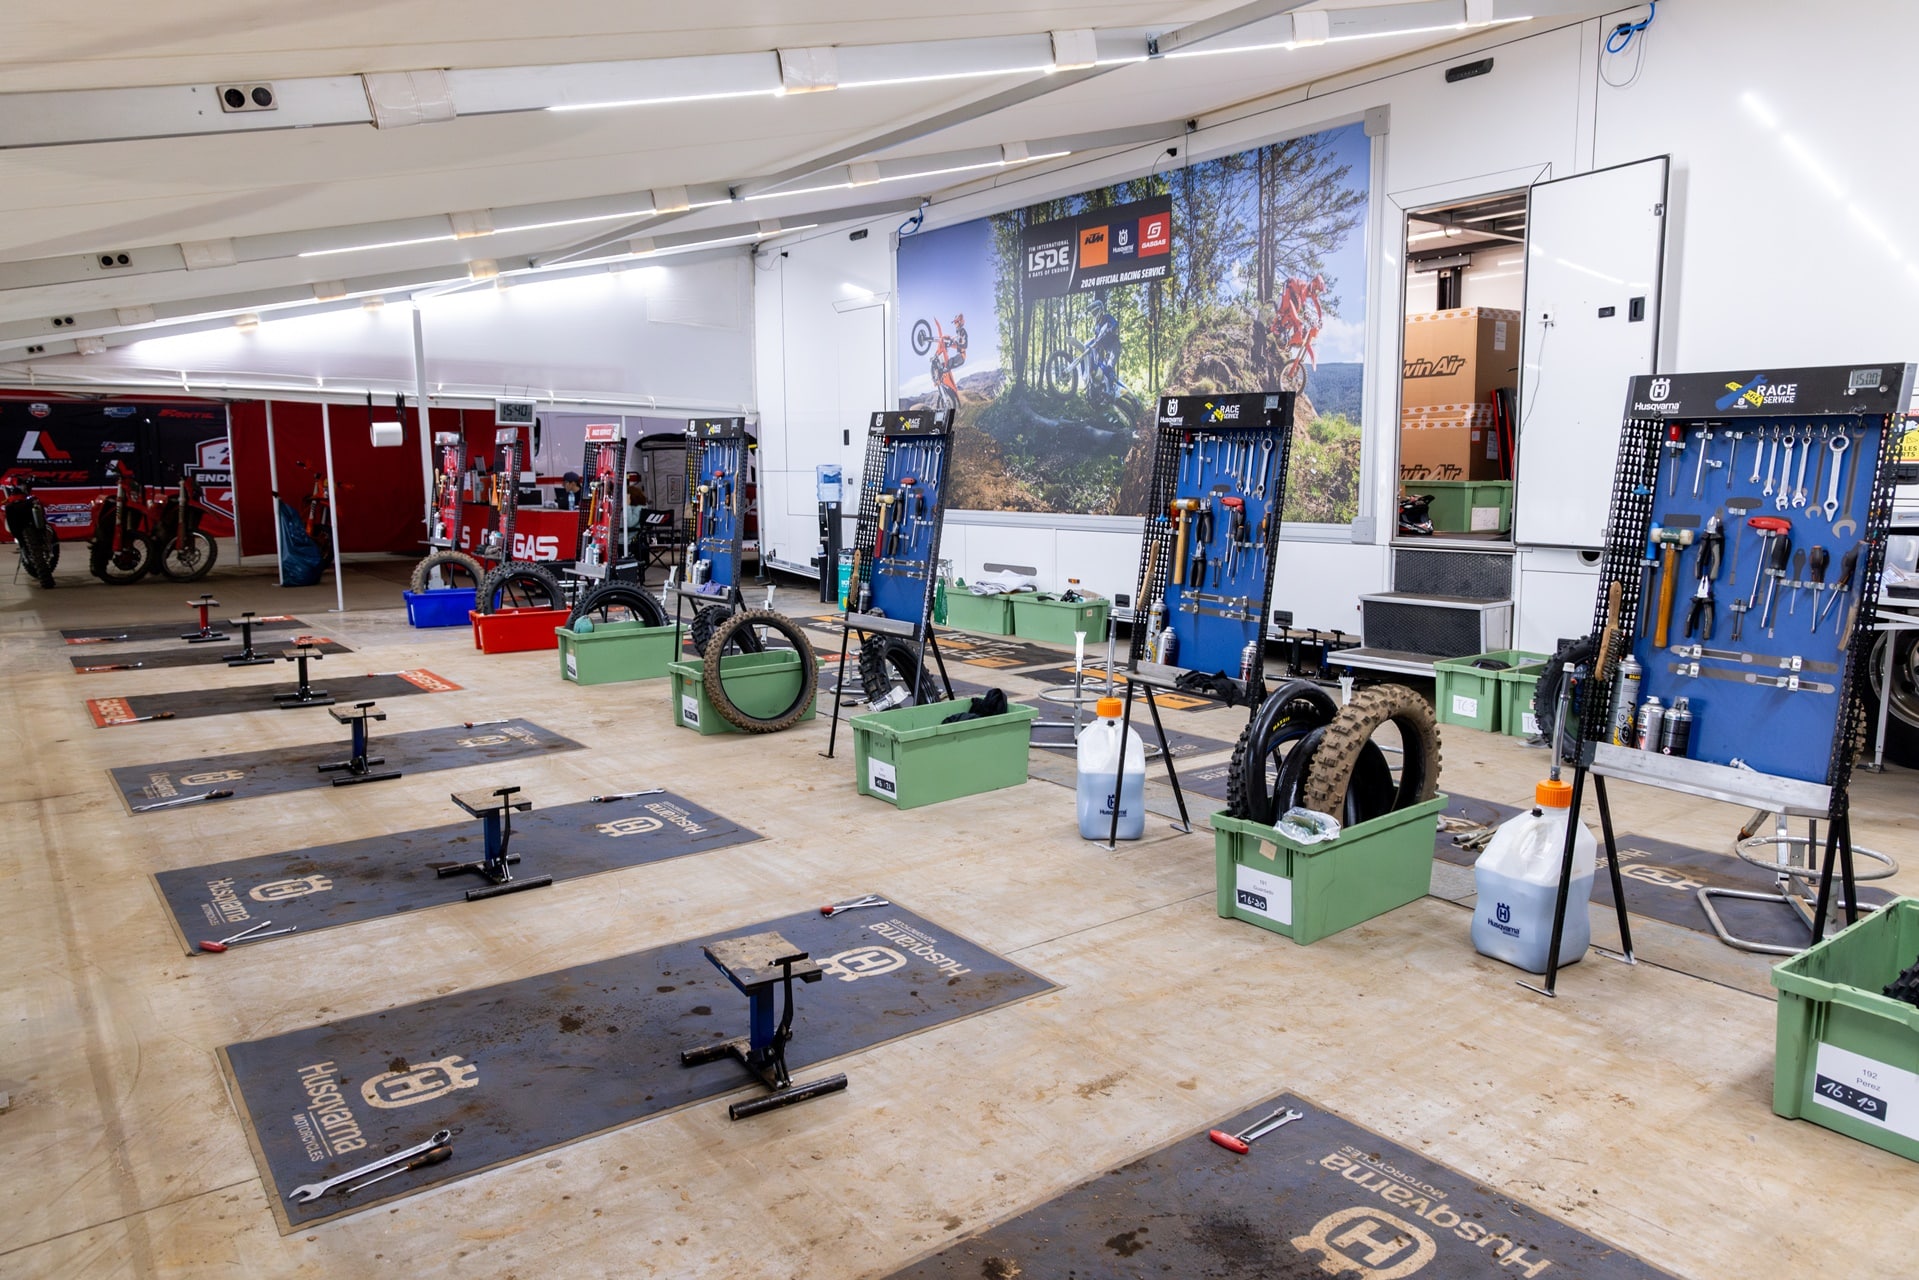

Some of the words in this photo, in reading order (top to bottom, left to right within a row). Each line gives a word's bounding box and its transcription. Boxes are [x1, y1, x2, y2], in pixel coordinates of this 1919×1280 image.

[1085, 232, 1104, 245] KTM
[1142, 239, 1166, 249] GASGAS
[1029, 246, 1069, 272] ISDE
[1081, 279, 1096, 288] 2024
[1096, 274, 1119, 286] OFFICIAL
[1120, 270, 1141, 281] RACING
[1141, 265, 1166, 278] SERVICE
[1404, 358, 1434, 378] win
[1756, 384, 1798, 396] RACE
[1634, 402, 1680, 412] Husqvarna
[1763, 395, 1796, 404] SERVICE
[503, 404, 528, 416] 15:40
[1220, 405, 1240, 414] RACE
[207, 877, 251, 923] Husqvarna
[1241, 894, 1265, 909] 16:20
[1488, 918, 1520, 935] Husqvarna
[869, 922, 972, 977] Husqvarna
[1863, 1069, 1878, 1079] 192
[1856, 1077, 1880, 1091] Perez
[297, 1061, 368, 1155] Husqvarna
[292, 1114, 324, 1162] MOTORCYCLES
[1341, 1145, 1448, 1199] MOTORCYCLES
[1319, 1152, 1551, 1279] Husqvarna
